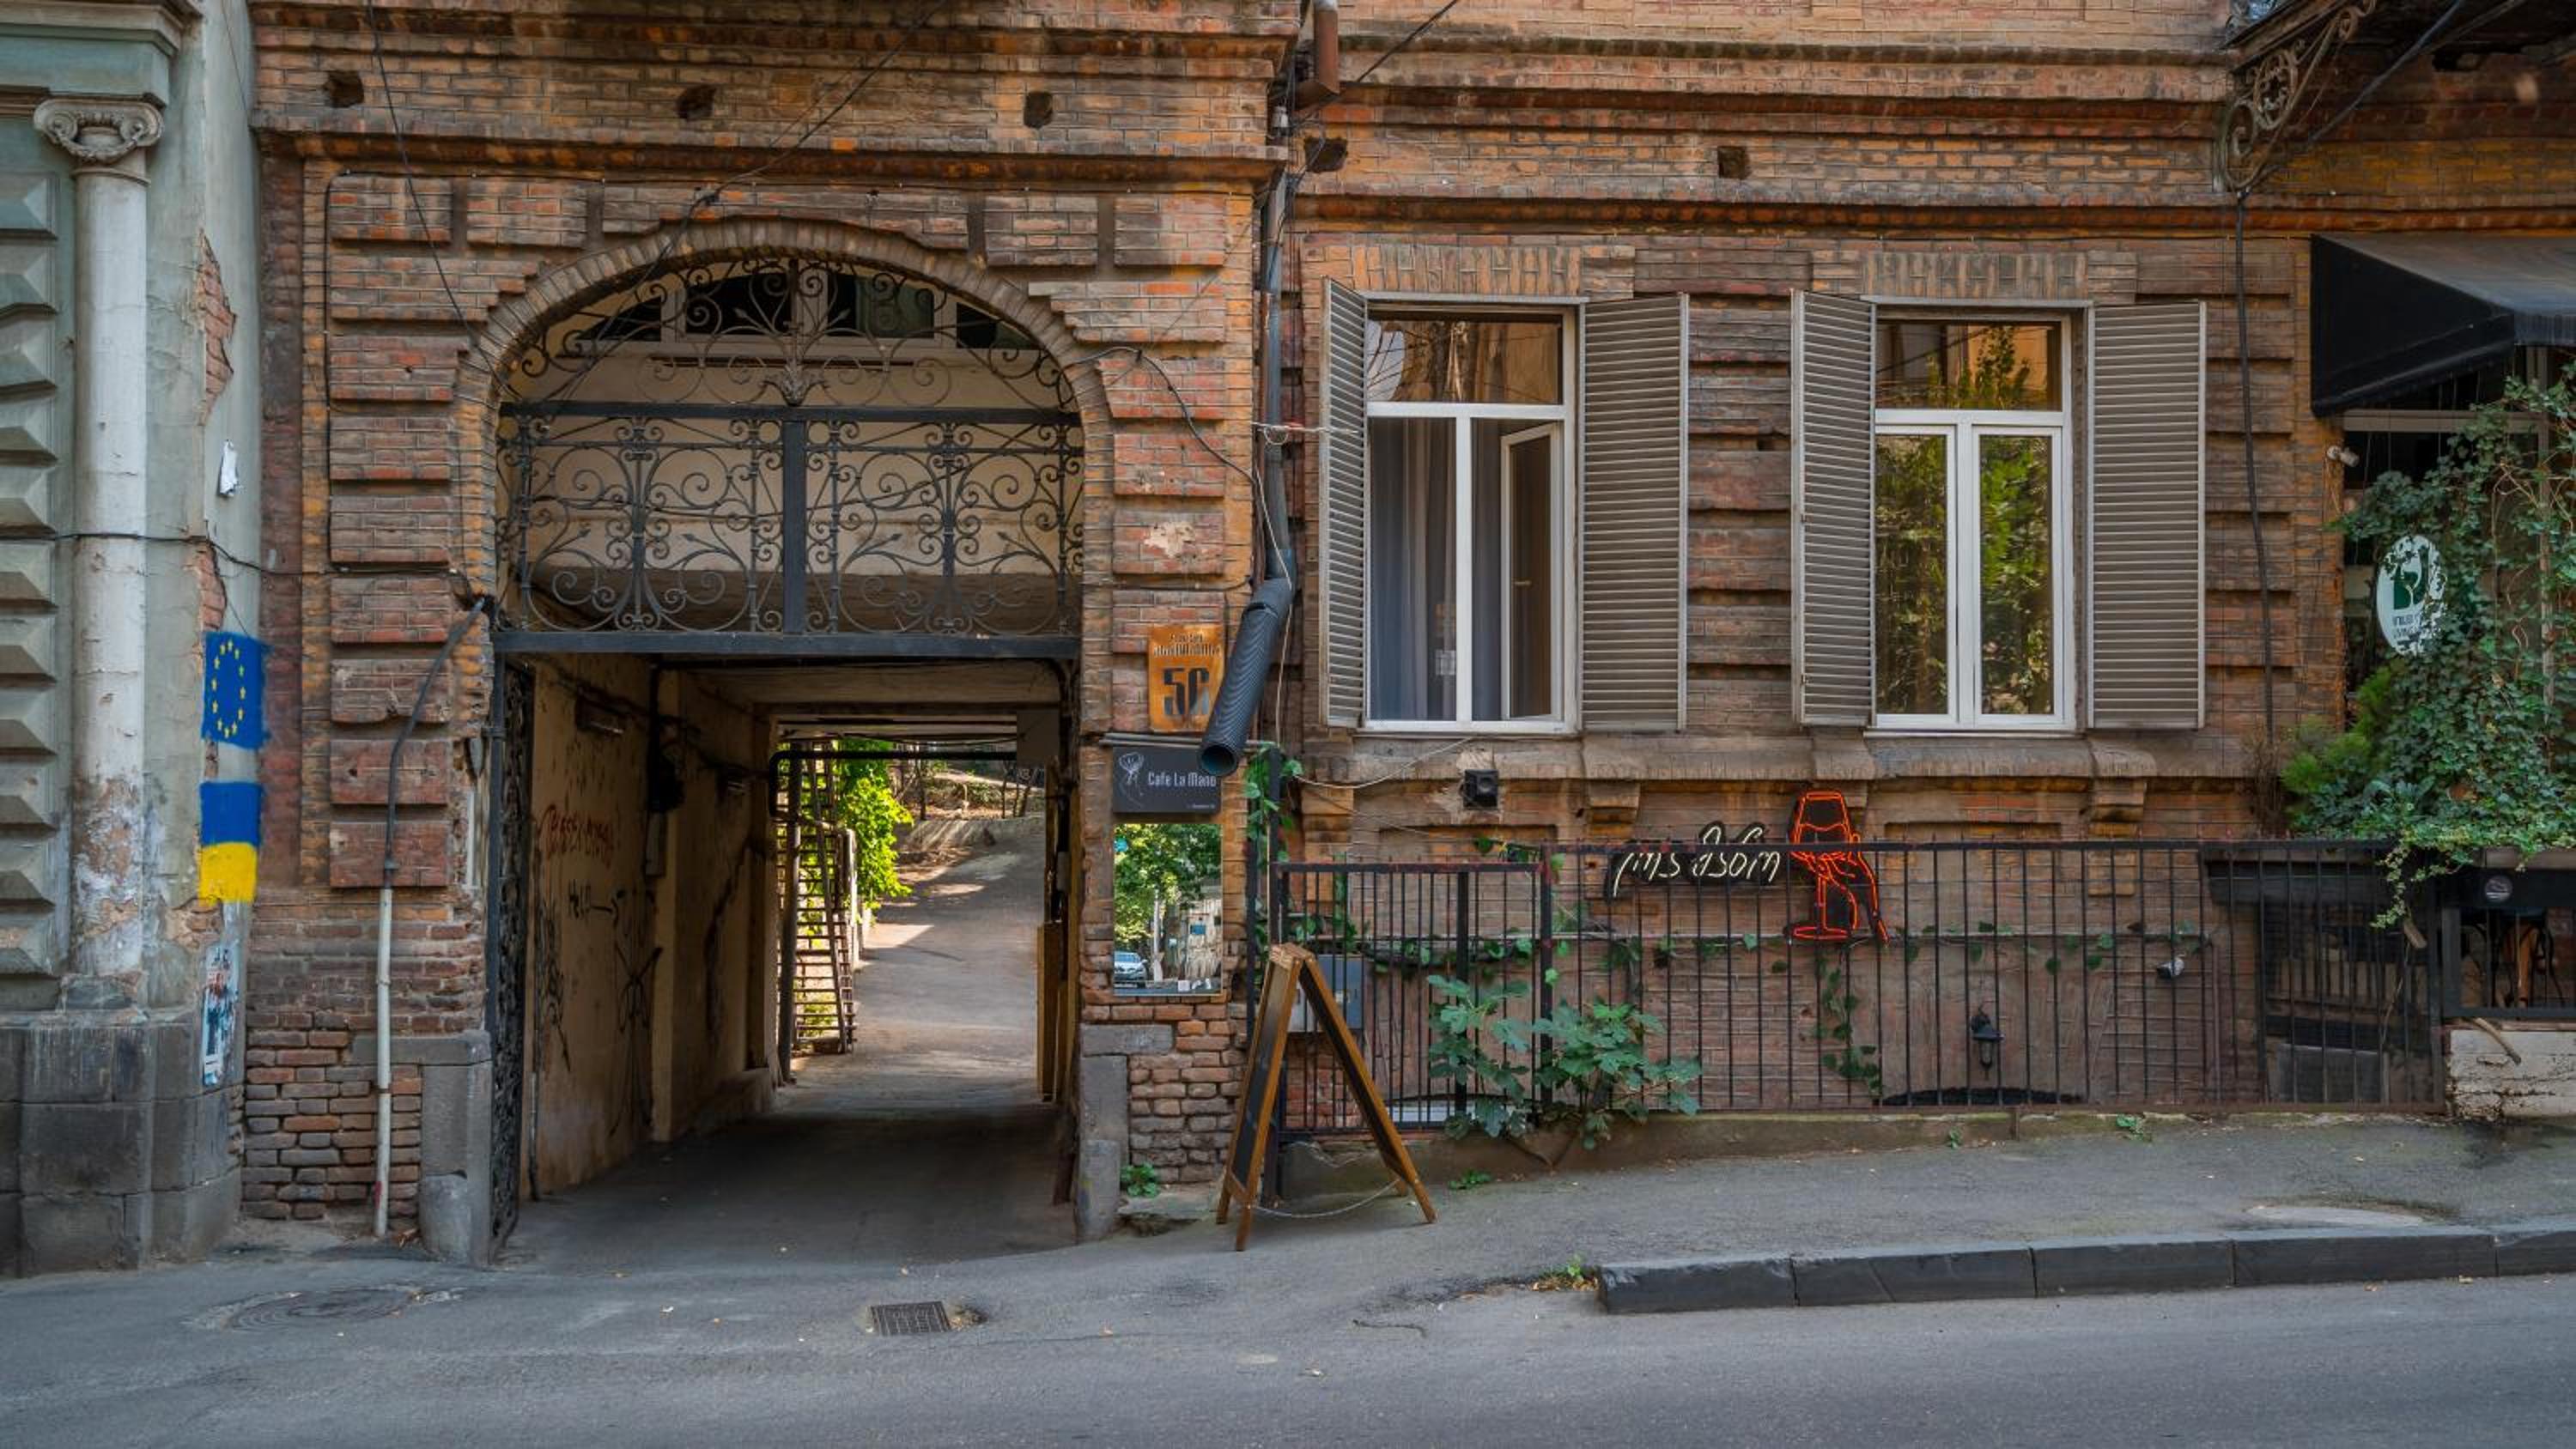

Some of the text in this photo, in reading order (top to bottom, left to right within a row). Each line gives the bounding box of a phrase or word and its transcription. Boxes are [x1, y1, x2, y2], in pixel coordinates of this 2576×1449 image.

[1148, 771, 1217, 787] Cafe La Mano
